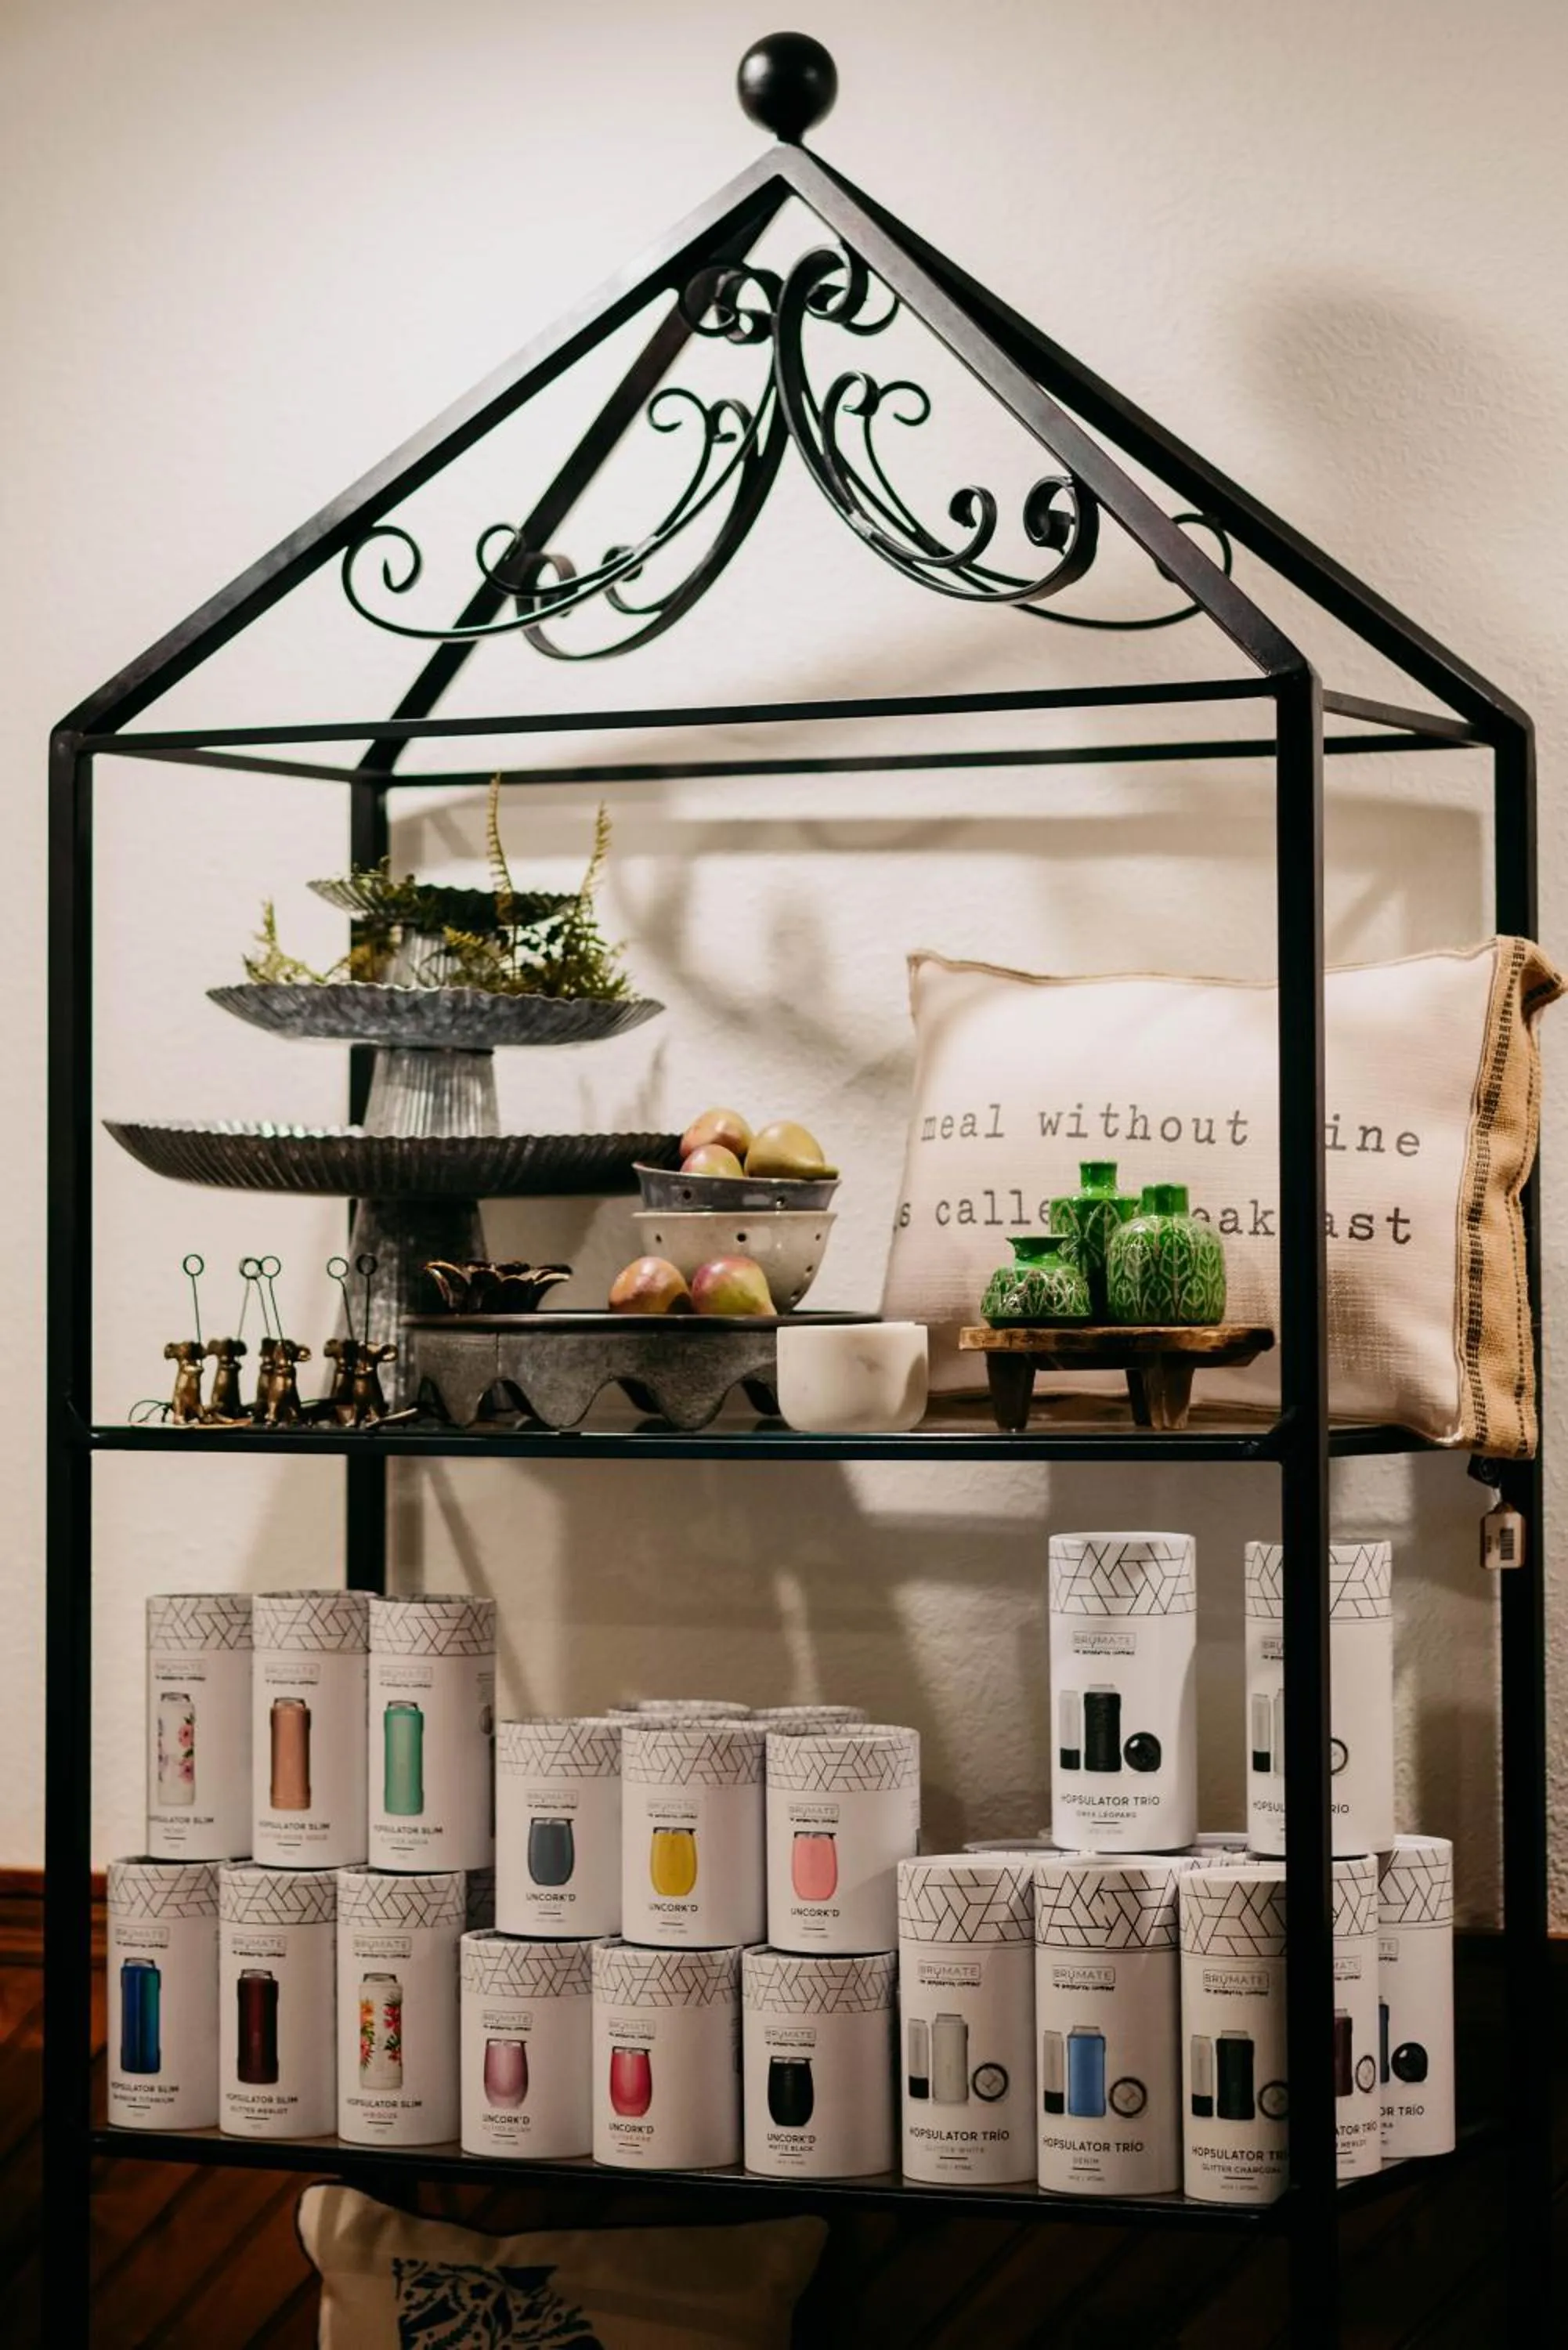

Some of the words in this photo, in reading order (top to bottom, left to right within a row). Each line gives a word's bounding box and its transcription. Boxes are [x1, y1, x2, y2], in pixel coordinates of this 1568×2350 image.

[920, 1103, 1005, 1141] meal
[1038, 1101, 1249, 1146] without
[1325, 1113, 1421, 1157] ine
[935, 1188, 1051, 1227] calle
[1330, 1803, 1350, 1814] RIO
[1042, 2135, 1111, 2153] HOPSULATOR
[1191, 2146, 1266, 2161] HOPSULATOR
